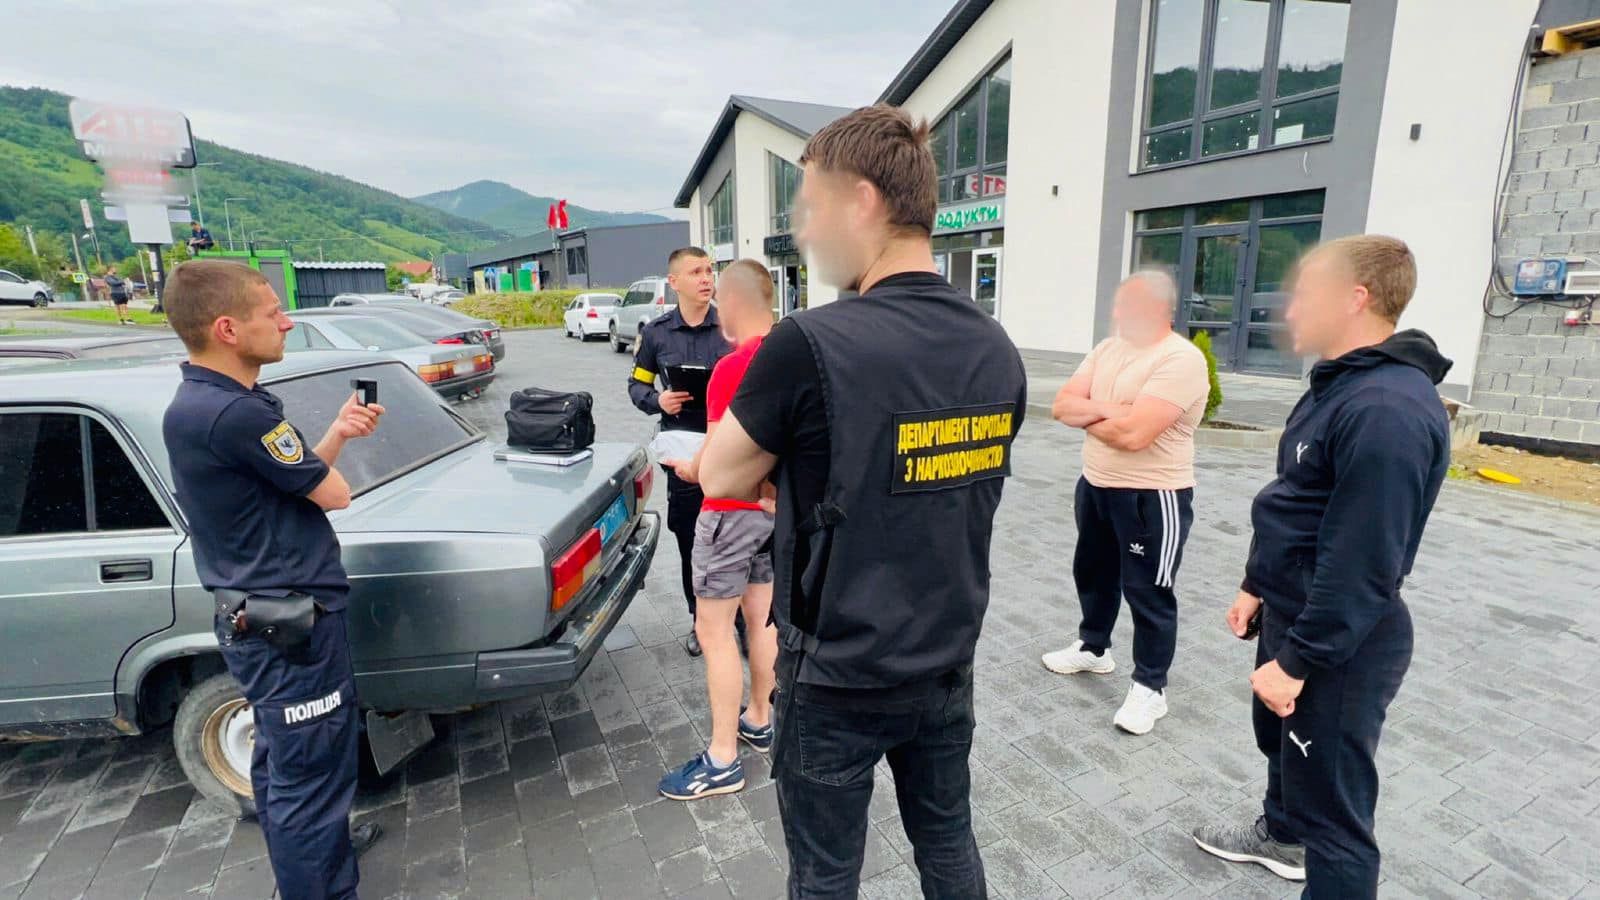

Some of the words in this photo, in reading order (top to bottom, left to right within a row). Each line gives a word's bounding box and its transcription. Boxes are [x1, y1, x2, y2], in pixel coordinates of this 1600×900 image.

[937, 205, 998, 229] РОДУКТИ
[898, 418, 969, 455] ДЕПАРТАМЕНТ
[973, 413, 1012, 440] БОРОТЬБИ
[284, 690, 342, 724] ПОЛІЦІЯ
